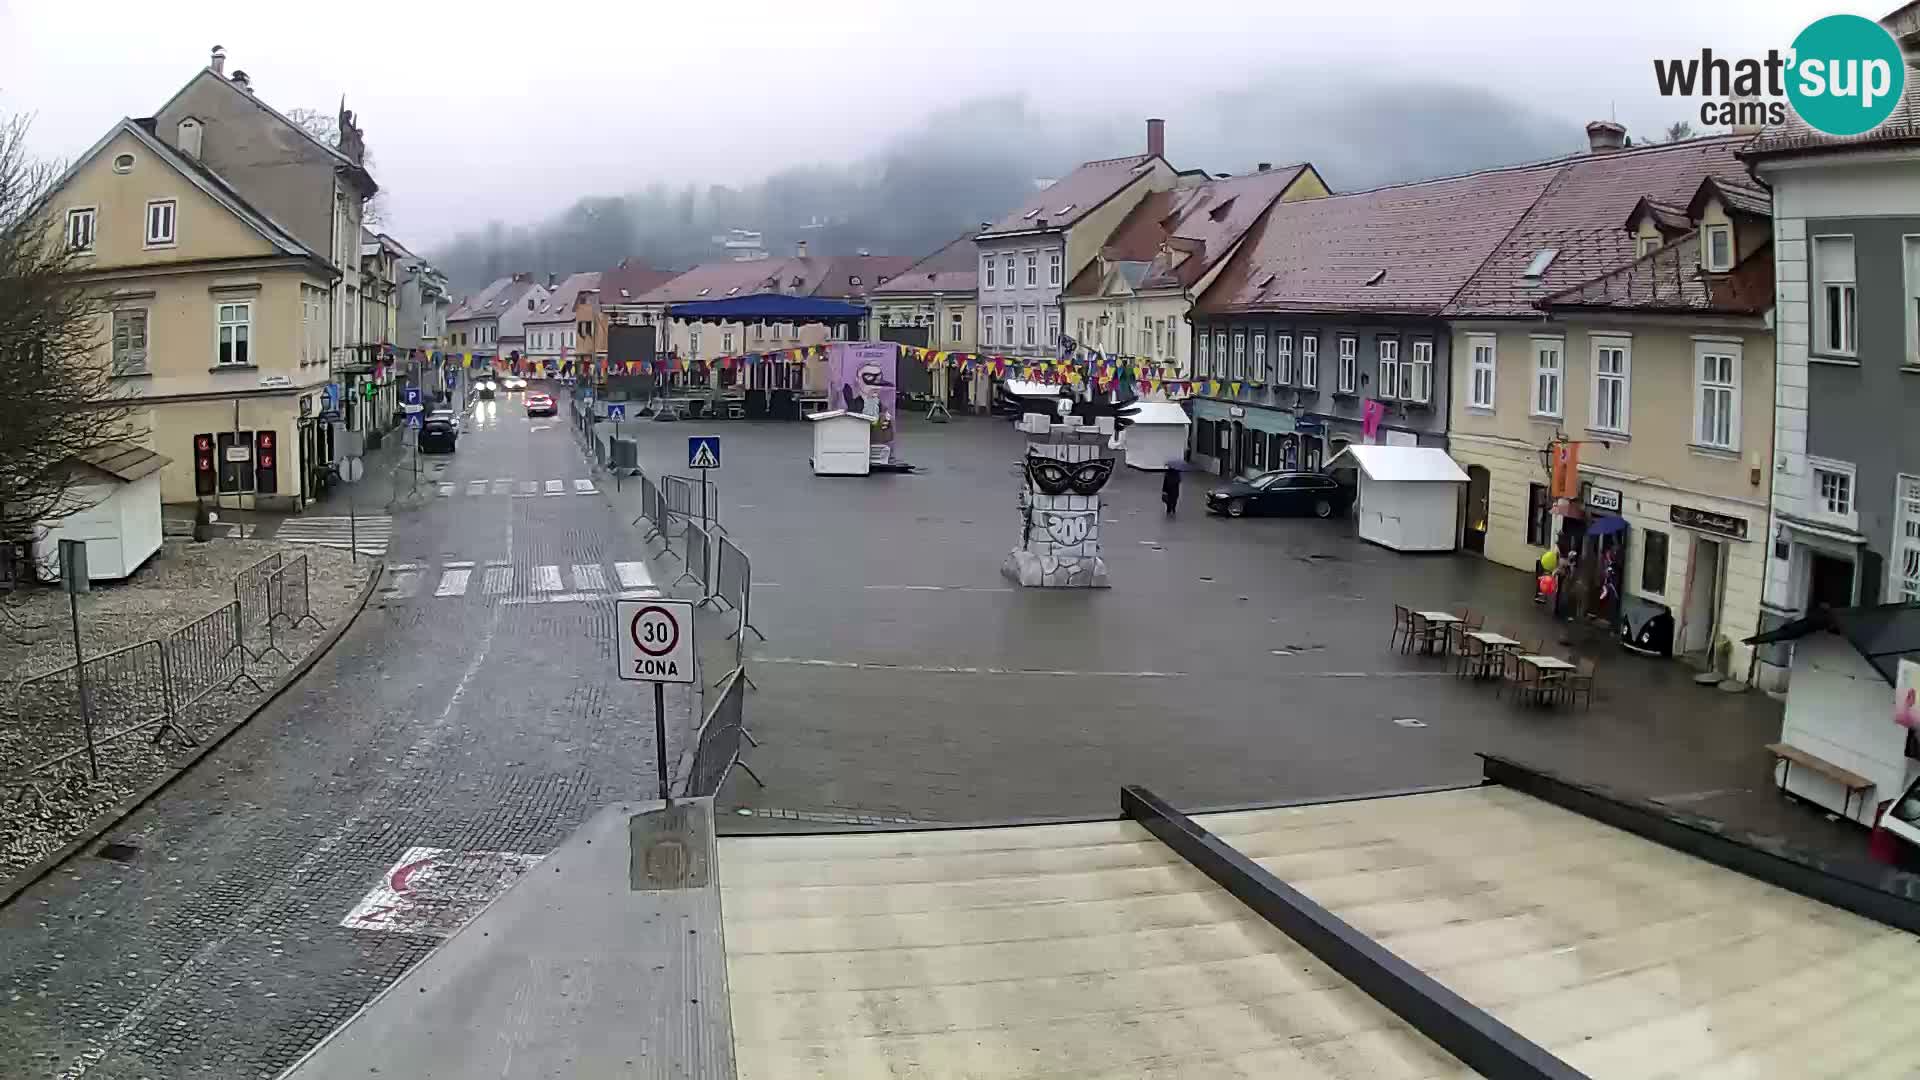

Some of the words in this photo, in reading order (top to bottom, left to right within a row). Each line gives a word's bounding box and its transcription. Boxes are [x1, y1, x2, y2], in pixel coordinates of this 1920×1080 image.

[408, 391, 417, 402] P
[643, 621, 668, 643] 30
[634, 659, 678, 676] ZONA
